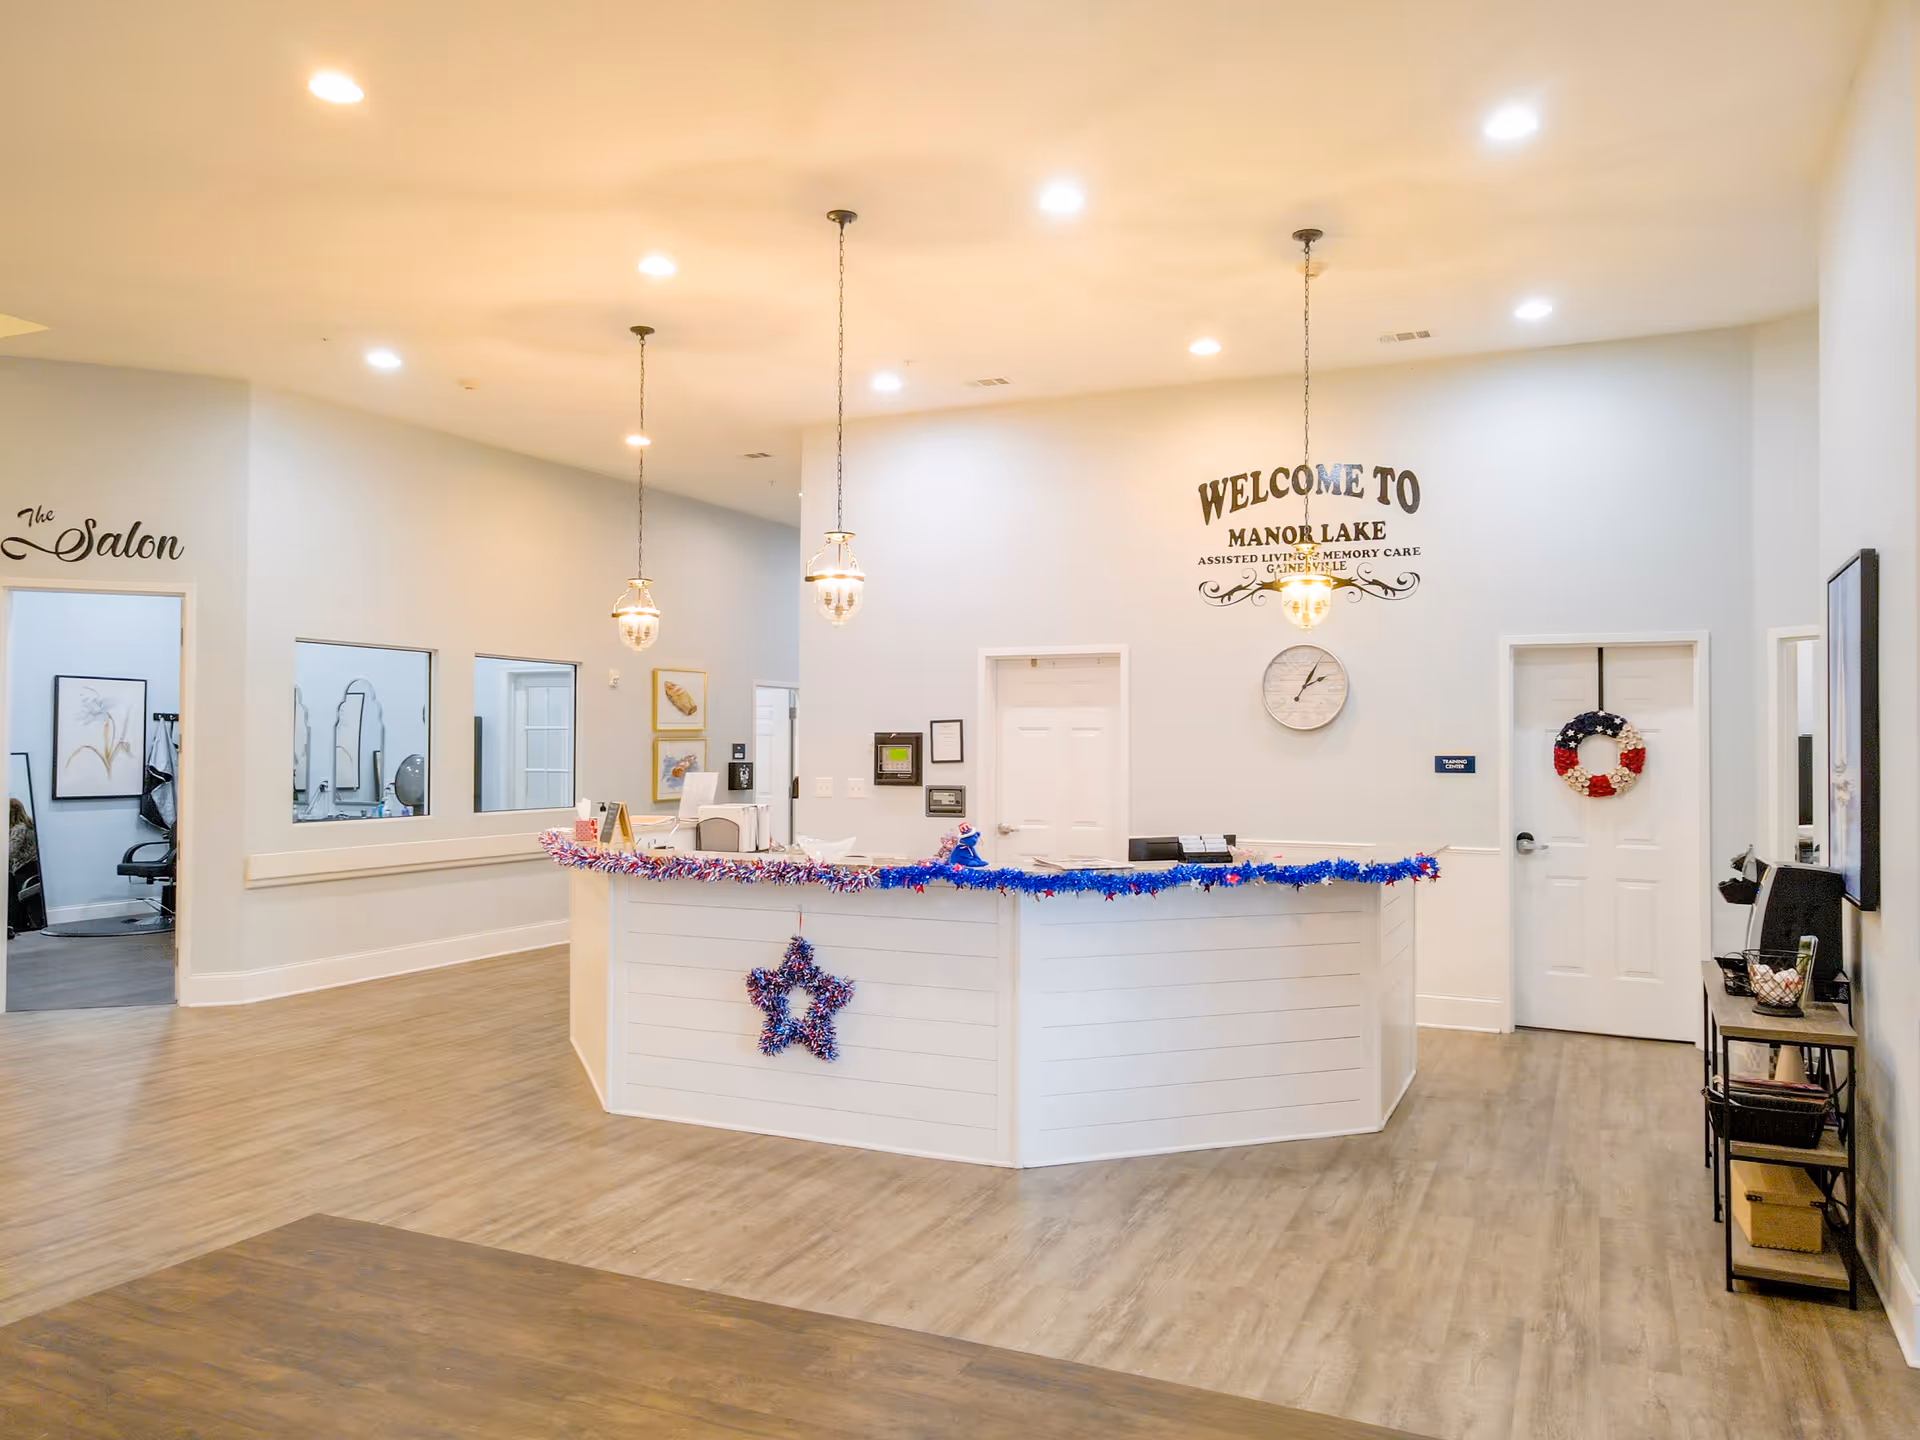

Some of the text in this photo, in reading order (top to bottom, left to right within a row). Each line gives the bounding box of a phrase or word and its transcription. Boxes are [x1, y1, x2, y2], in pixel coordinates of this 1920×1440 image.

[1198, 463, 1421, 526] WELCOME TO
[17, 505, 56, 528] The
[0, 518, 185, 563] Salon
[1228, 521, 1387, 547] MANOR LAKE
[1198, 554, 1259, 566] ASSISTED
[1261, 552, 1306, 563] LIVING
[1323, 549, 1380, 560] MEMORY
[1383, 547, 1422, 558] CARE
